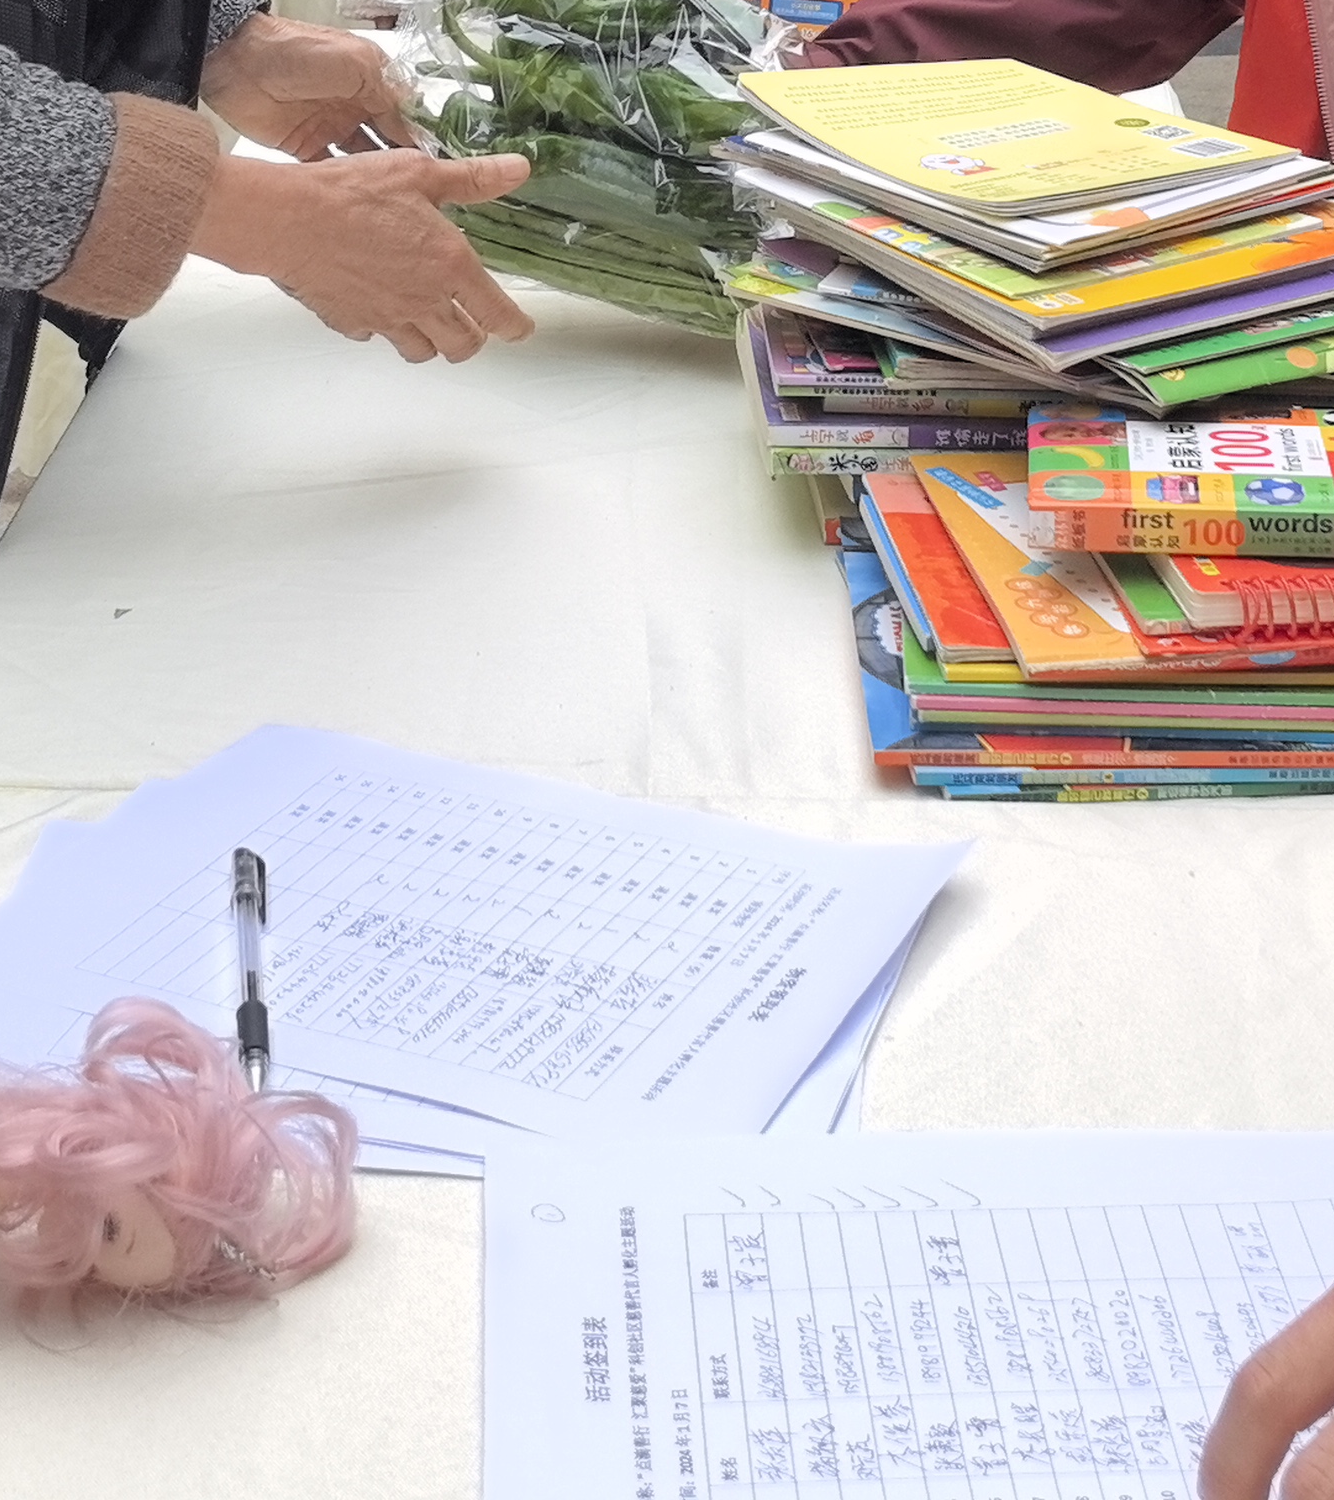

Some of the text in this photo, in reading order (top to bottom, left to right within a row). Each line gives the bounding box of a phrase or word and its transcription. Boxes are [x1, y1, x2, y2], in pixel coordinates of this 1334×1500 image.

[1120, 507, 1175, 530] first
[1183, 518, 1245, 547] 100
[1247, 513, 1334, 534] words
[581, 1316, 611, 1402] 活动签到表
[701, 1268, 738, 1481] 姓名 联系方式 备注
